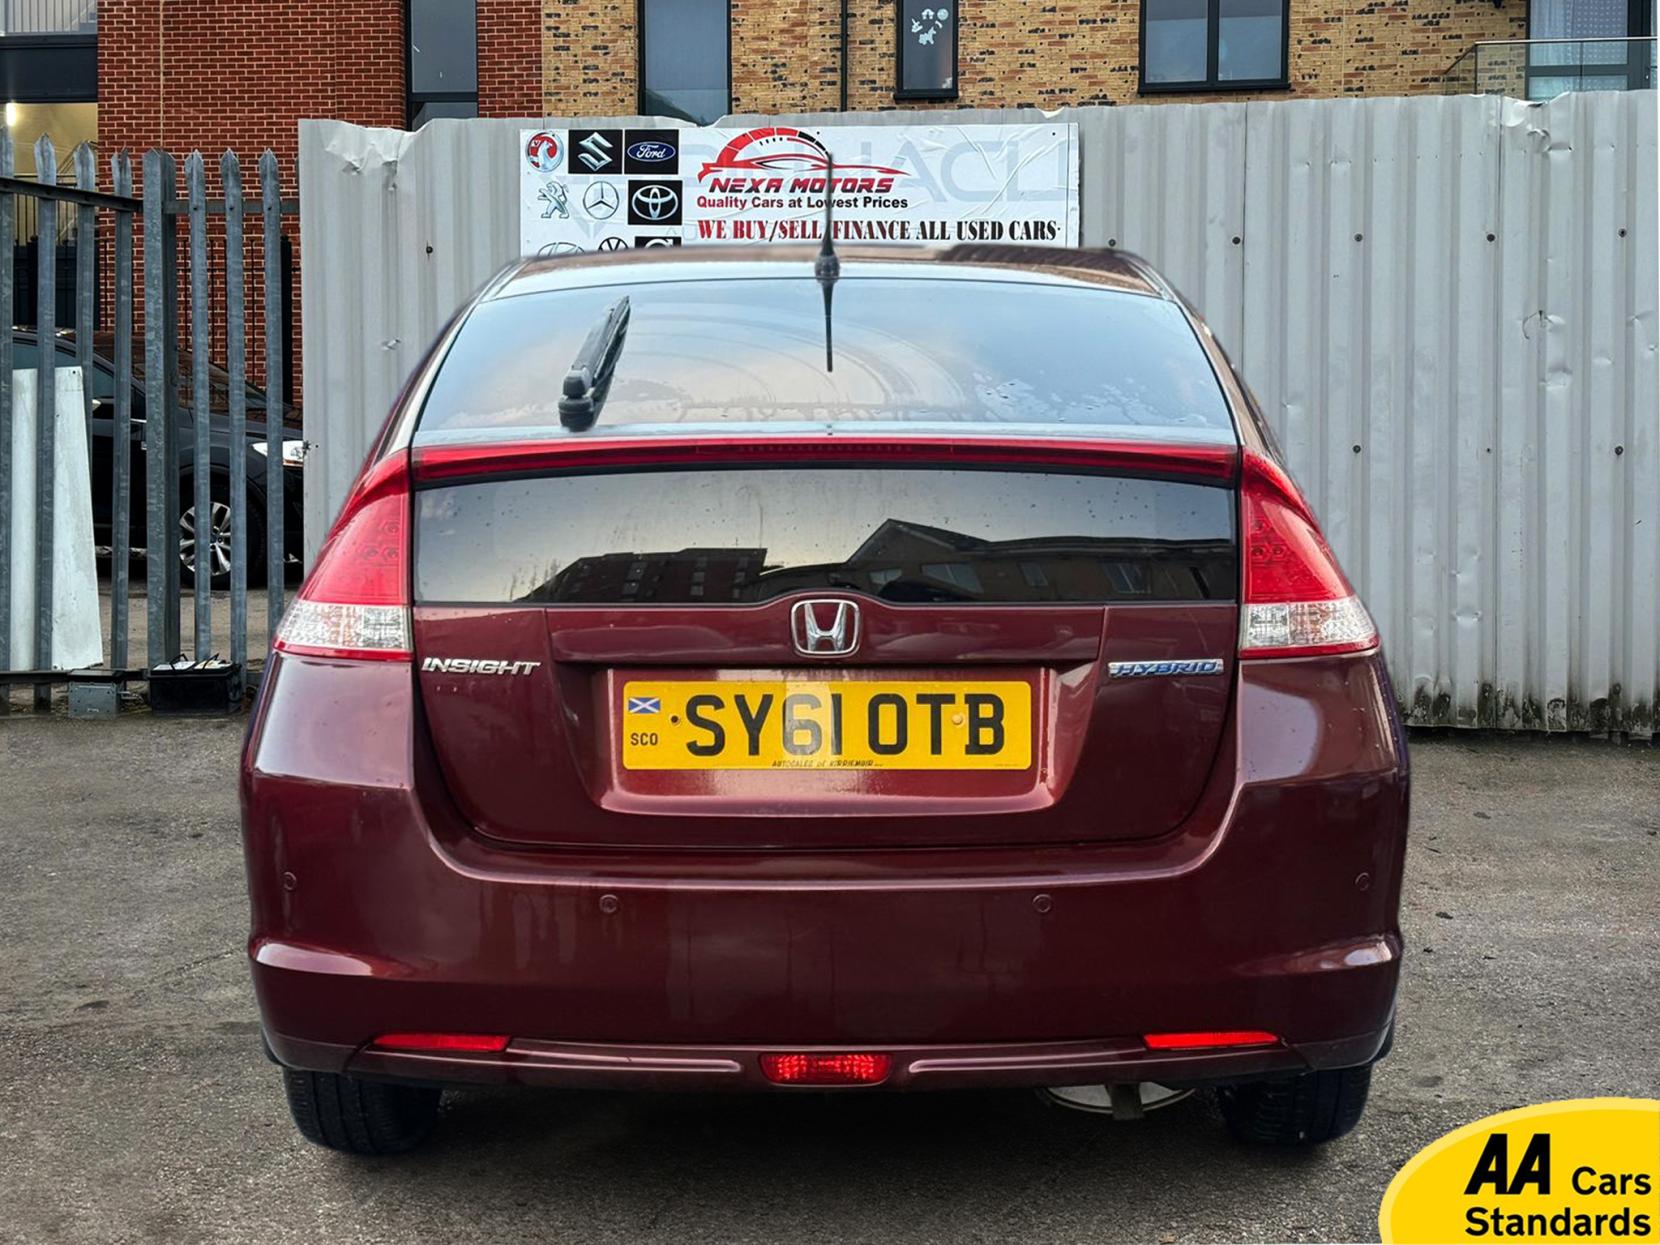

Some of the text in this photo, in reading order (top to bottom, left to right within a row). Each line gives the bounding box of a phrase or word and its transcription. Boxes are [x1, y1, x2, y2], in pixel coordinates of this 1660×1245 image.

[636, 144, 666, 158] Ford
[709, 178, 894, 193] NEXA MOTORS
[697, 196, 747, 210] Quality
[752, 196, 784, 208] Cars
[788, 197, 803, 208] at
[863, 195, 908, 208] Prices
[698, 220, 727, 239] WE
[916, 220, 951, 240] ALL
[957, 220, 1003, 240] USED
[1009, 220, 1057, 240] CARS
[421, 657, 542, 675] INSIGHT
[1110, 660, 1220, 676] HYBRID
[686, 693, 1005, 756] SY61 OTB
[630, 732, 659, 746] SCO
